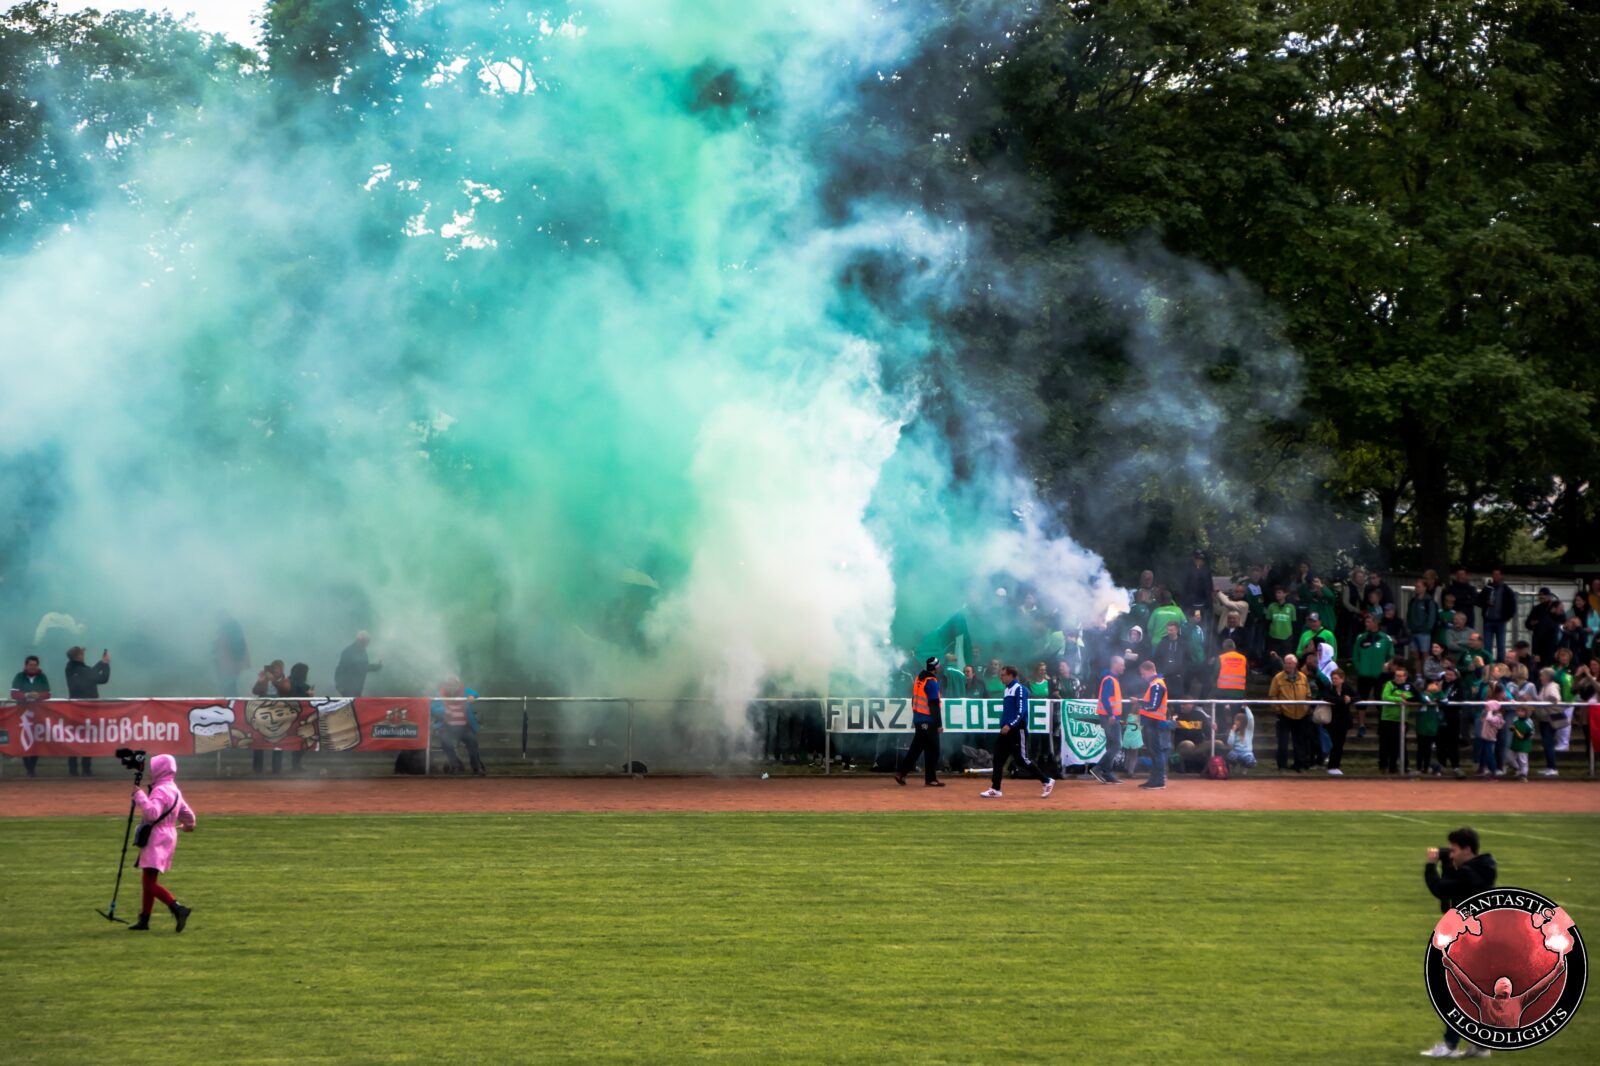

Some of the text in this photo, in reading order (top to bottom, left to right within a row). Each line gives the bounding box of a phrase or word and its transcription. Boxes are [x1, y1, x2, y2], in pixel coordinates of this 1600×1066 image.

[827, 699, 1047, 730] FORZ COSE
[1068, 705, 1099, 715] DRESD
[19, 710, 179, 752] Feldschlößchen
